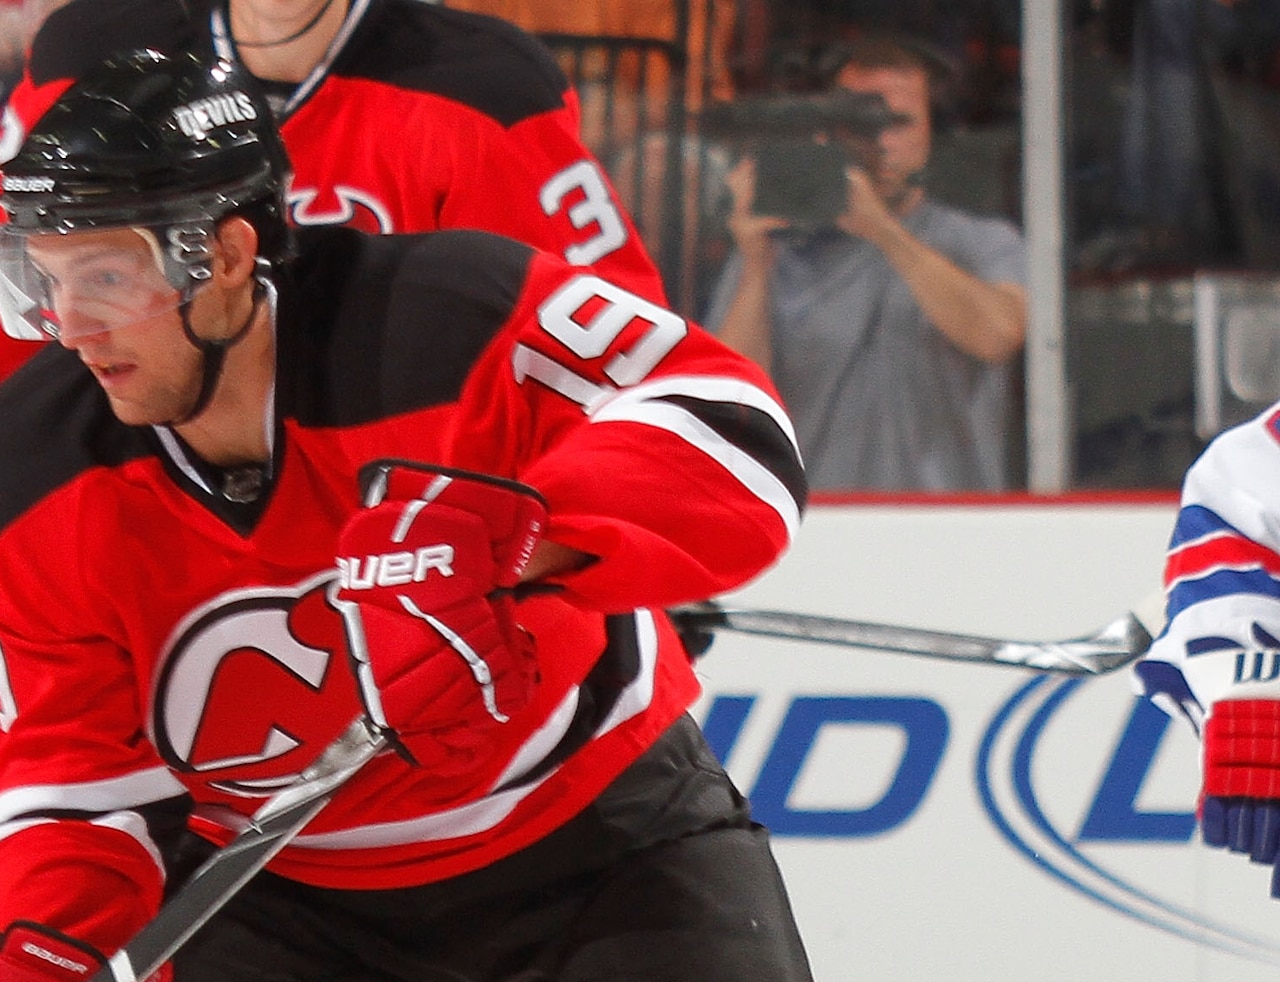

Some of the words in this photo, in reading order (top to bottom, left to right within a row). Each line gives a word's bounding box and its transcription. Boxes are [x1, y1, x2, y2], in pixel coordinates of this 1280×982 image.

[173, 90, 257, 140] DEVILS
[512, 274, 688, 415] 19
[334, 543, 455, 590] UER
